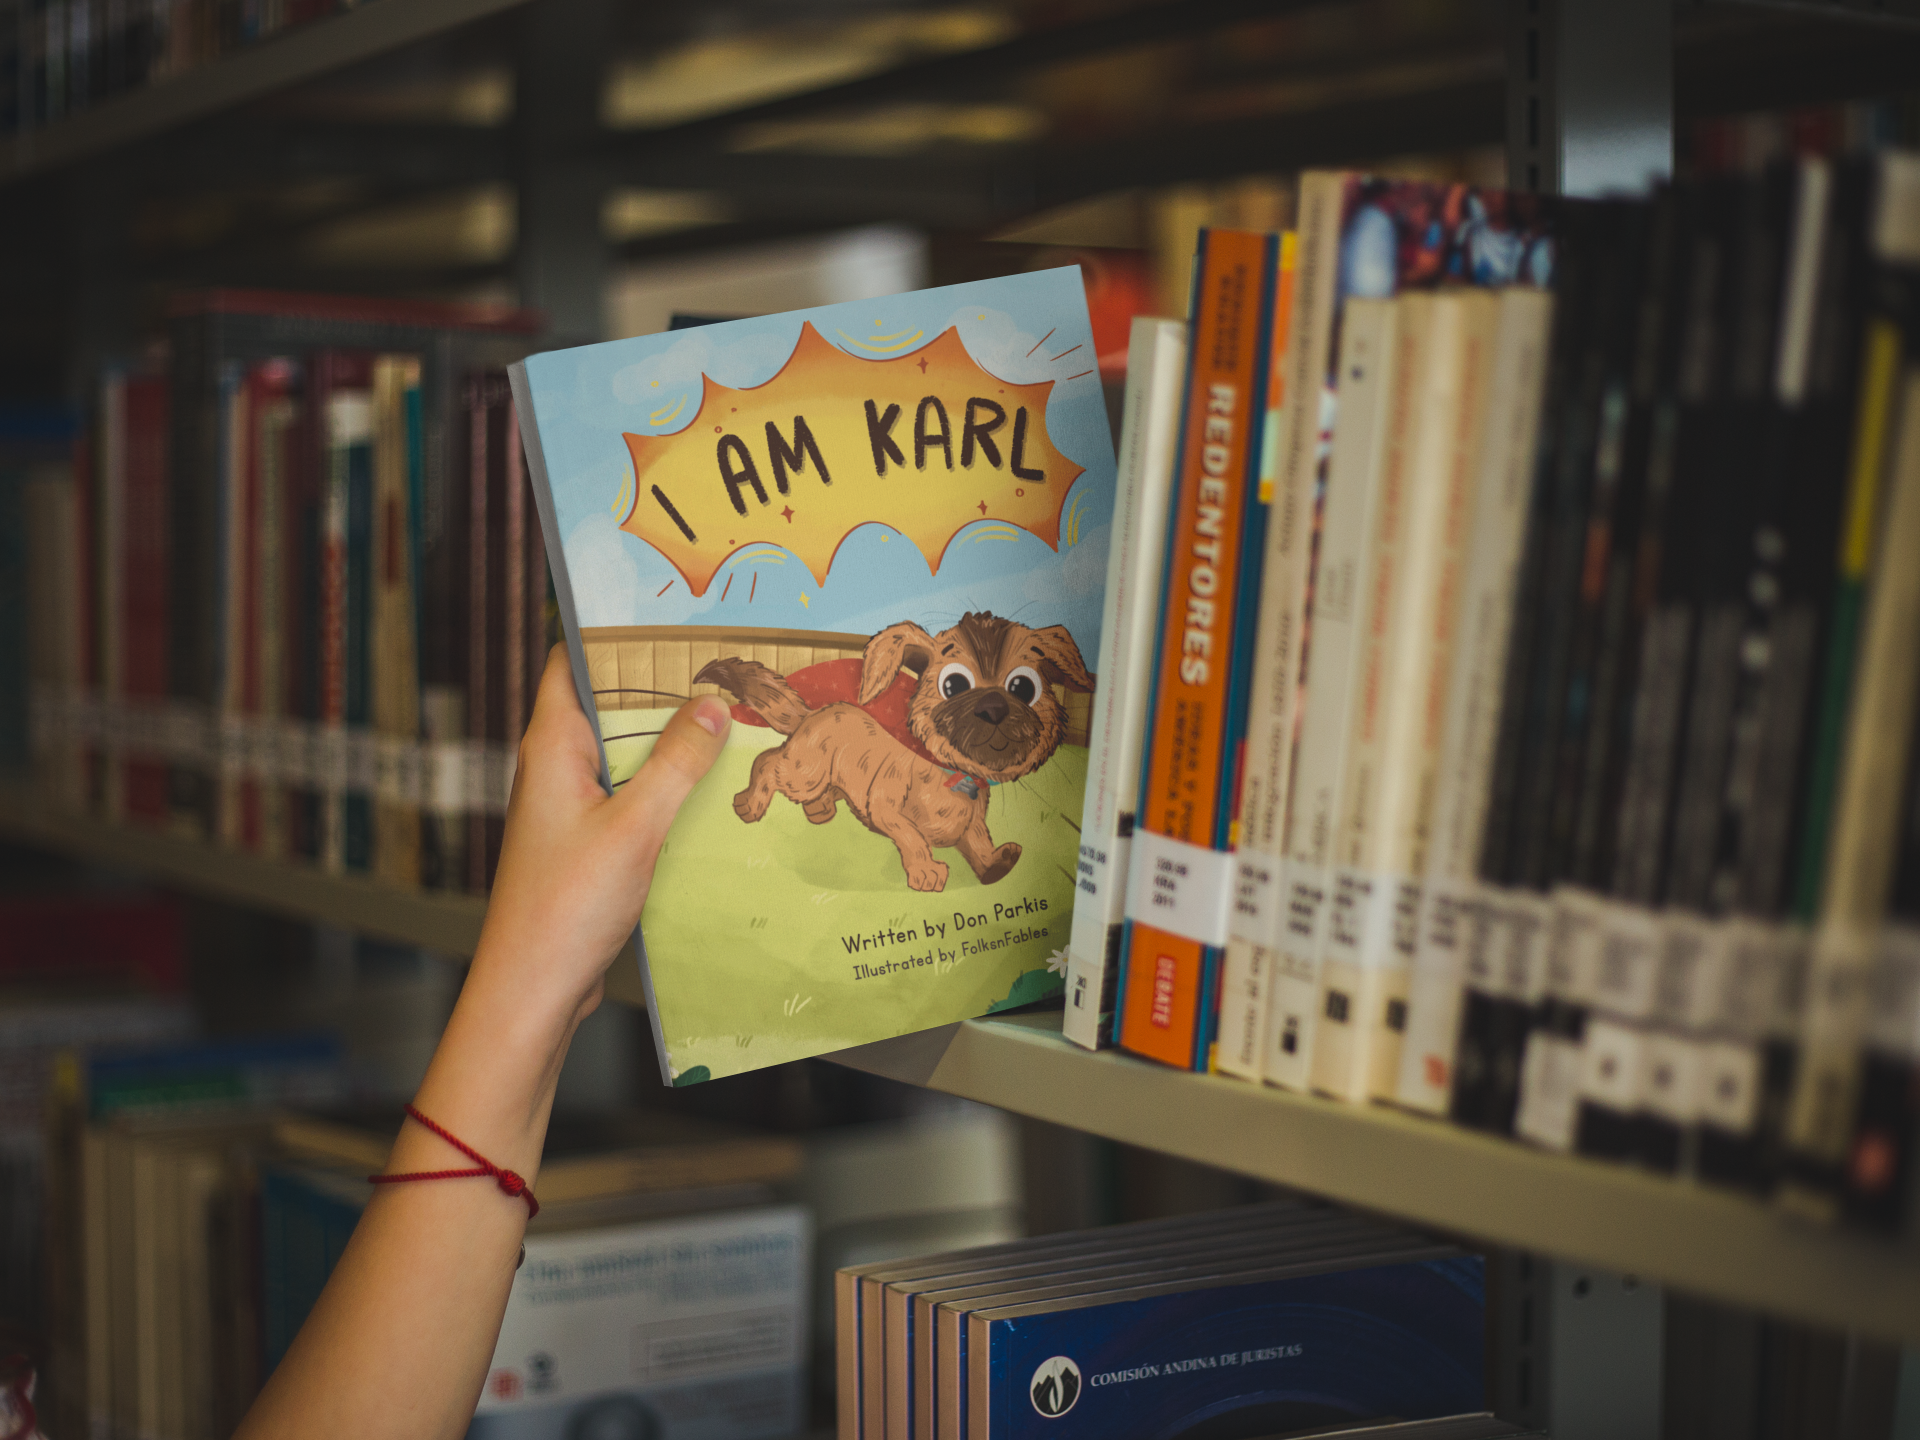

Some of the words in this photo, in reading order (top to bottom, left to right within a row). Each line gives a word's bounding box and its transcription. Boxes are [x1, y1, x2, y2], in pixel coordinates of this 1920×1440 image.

[650, 484, 697, 544] I
[716, 414, 833, 517] AM
[863, 395, 1045, 483] KARL
[1179, 382, 1237, 687] REDENTORES
[841, 928, 917, 954] Written
[923, 919, 946, 939] by
[953, 912, 988, 931] Don
[993, 897, 1049, 922] Parkis
[852, 949, 933, 981] Illustrated
[938, 948, 956, 963] by
[961, 926, 1049, 957] FolksnFables
[1152, 956, 1176, 1025] DEBATE
[1090, 1363, 1160, 1387] COMISIÓN
[1162, 1356, 1217, 1375] ANDINA
[1219, 1353, 1240, 1366] DE
[1240, 1344, 1303, 1366] JURISTAS
